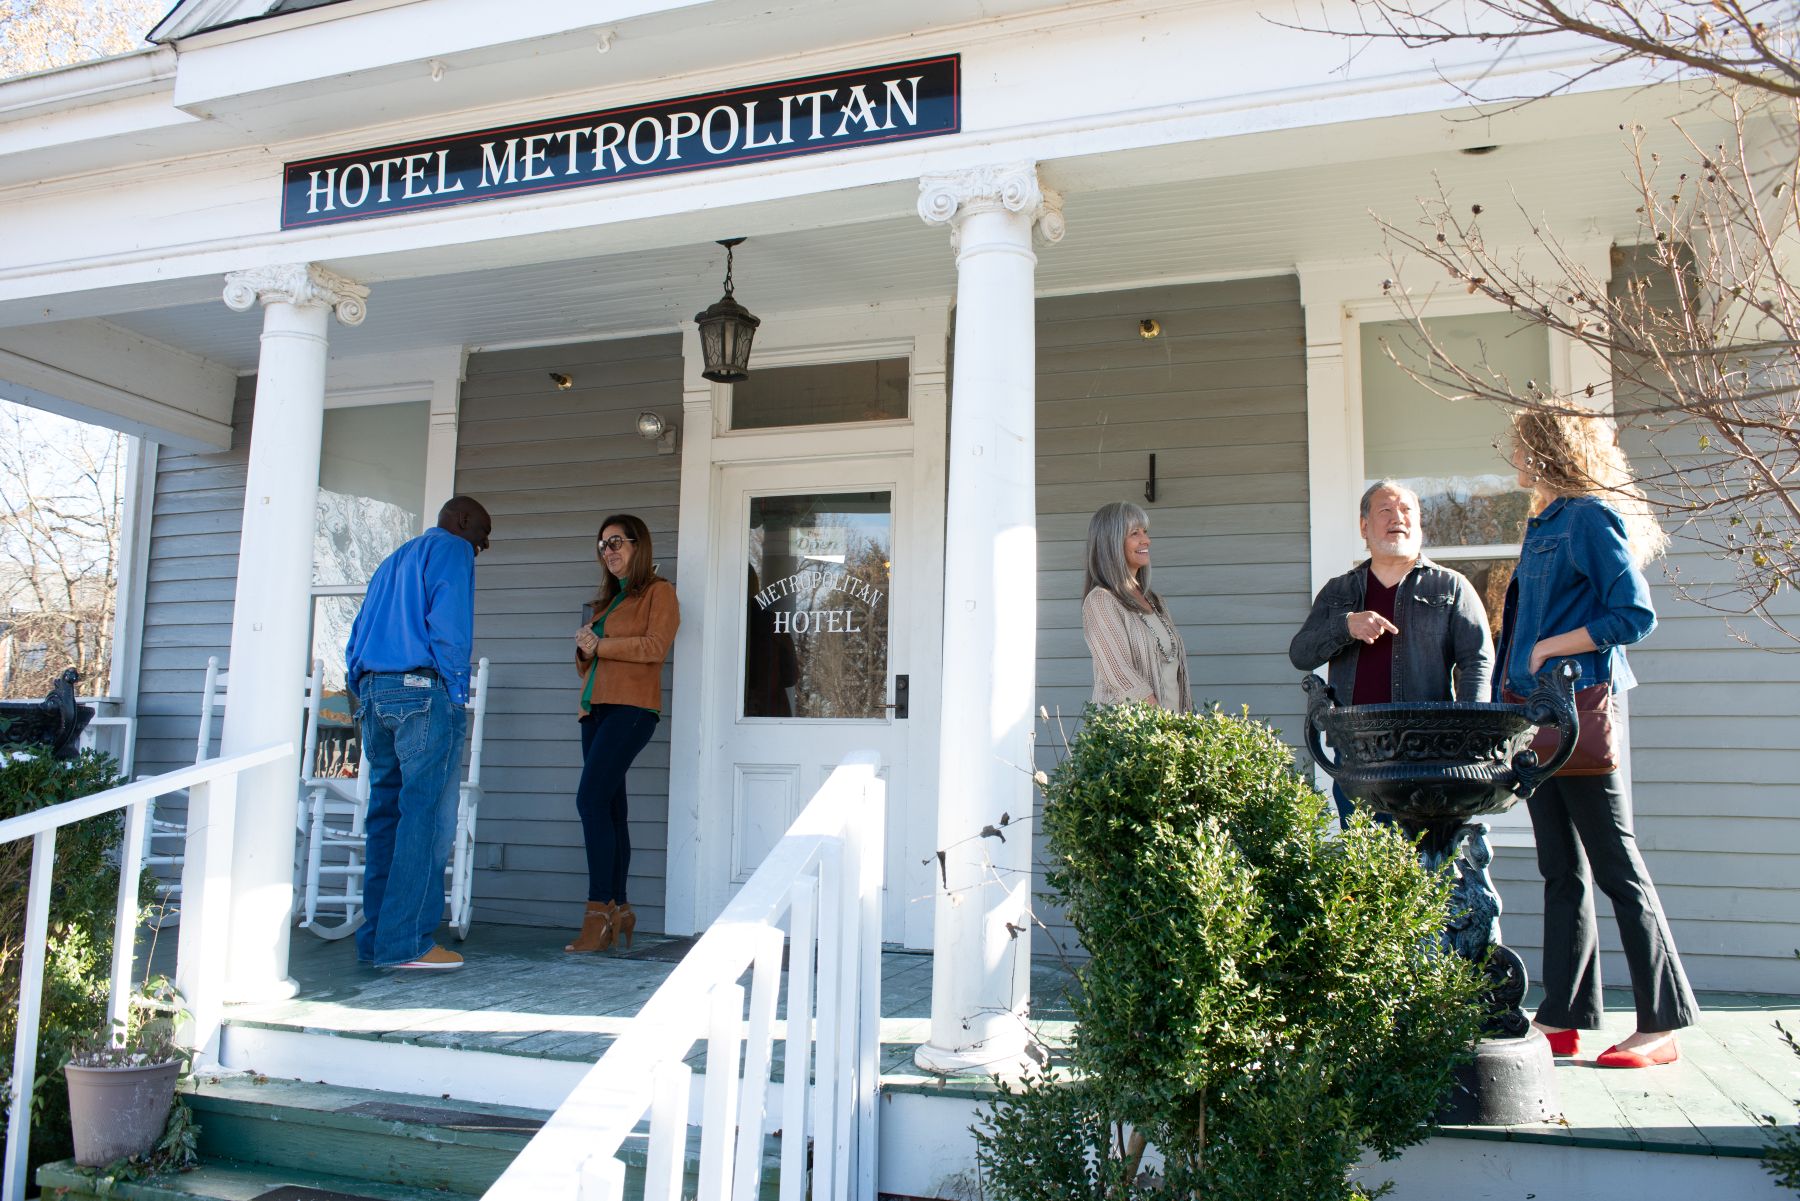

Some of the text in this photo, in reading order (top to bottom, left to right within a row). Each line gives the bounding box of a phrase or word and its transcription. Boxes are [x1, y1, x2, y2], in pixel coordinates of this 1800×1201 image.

[306, 76, 925, 214] HOTEL METROPOLITAN
[754, 572, 883, 610] METROPOLITAN
[774, 611, 861, 633] HOTEL
